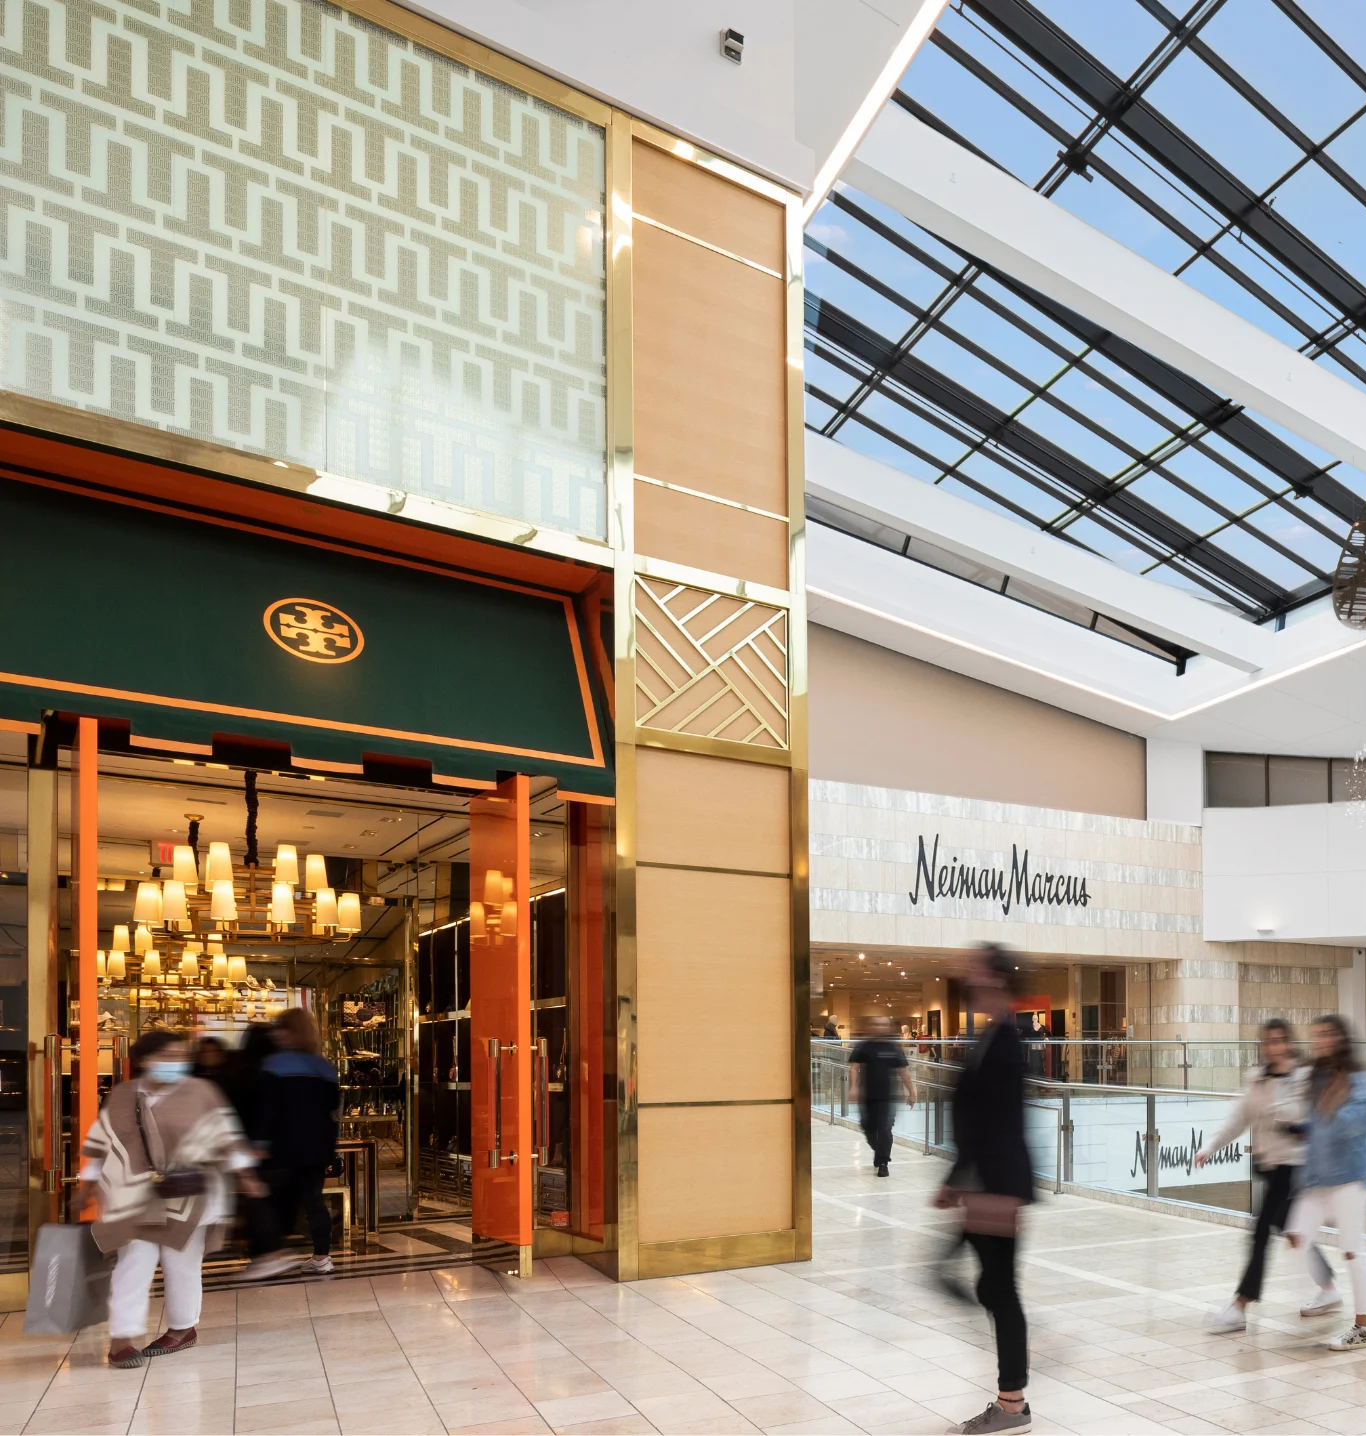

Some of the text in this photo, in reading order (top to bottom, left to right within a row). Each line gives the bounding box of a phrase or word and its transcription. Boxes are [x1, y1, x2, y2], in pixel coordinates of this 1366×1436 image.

[908, 833, 1092, 915] Neiman Marcus
[1130, 1130, 1190, 1178] Nman
